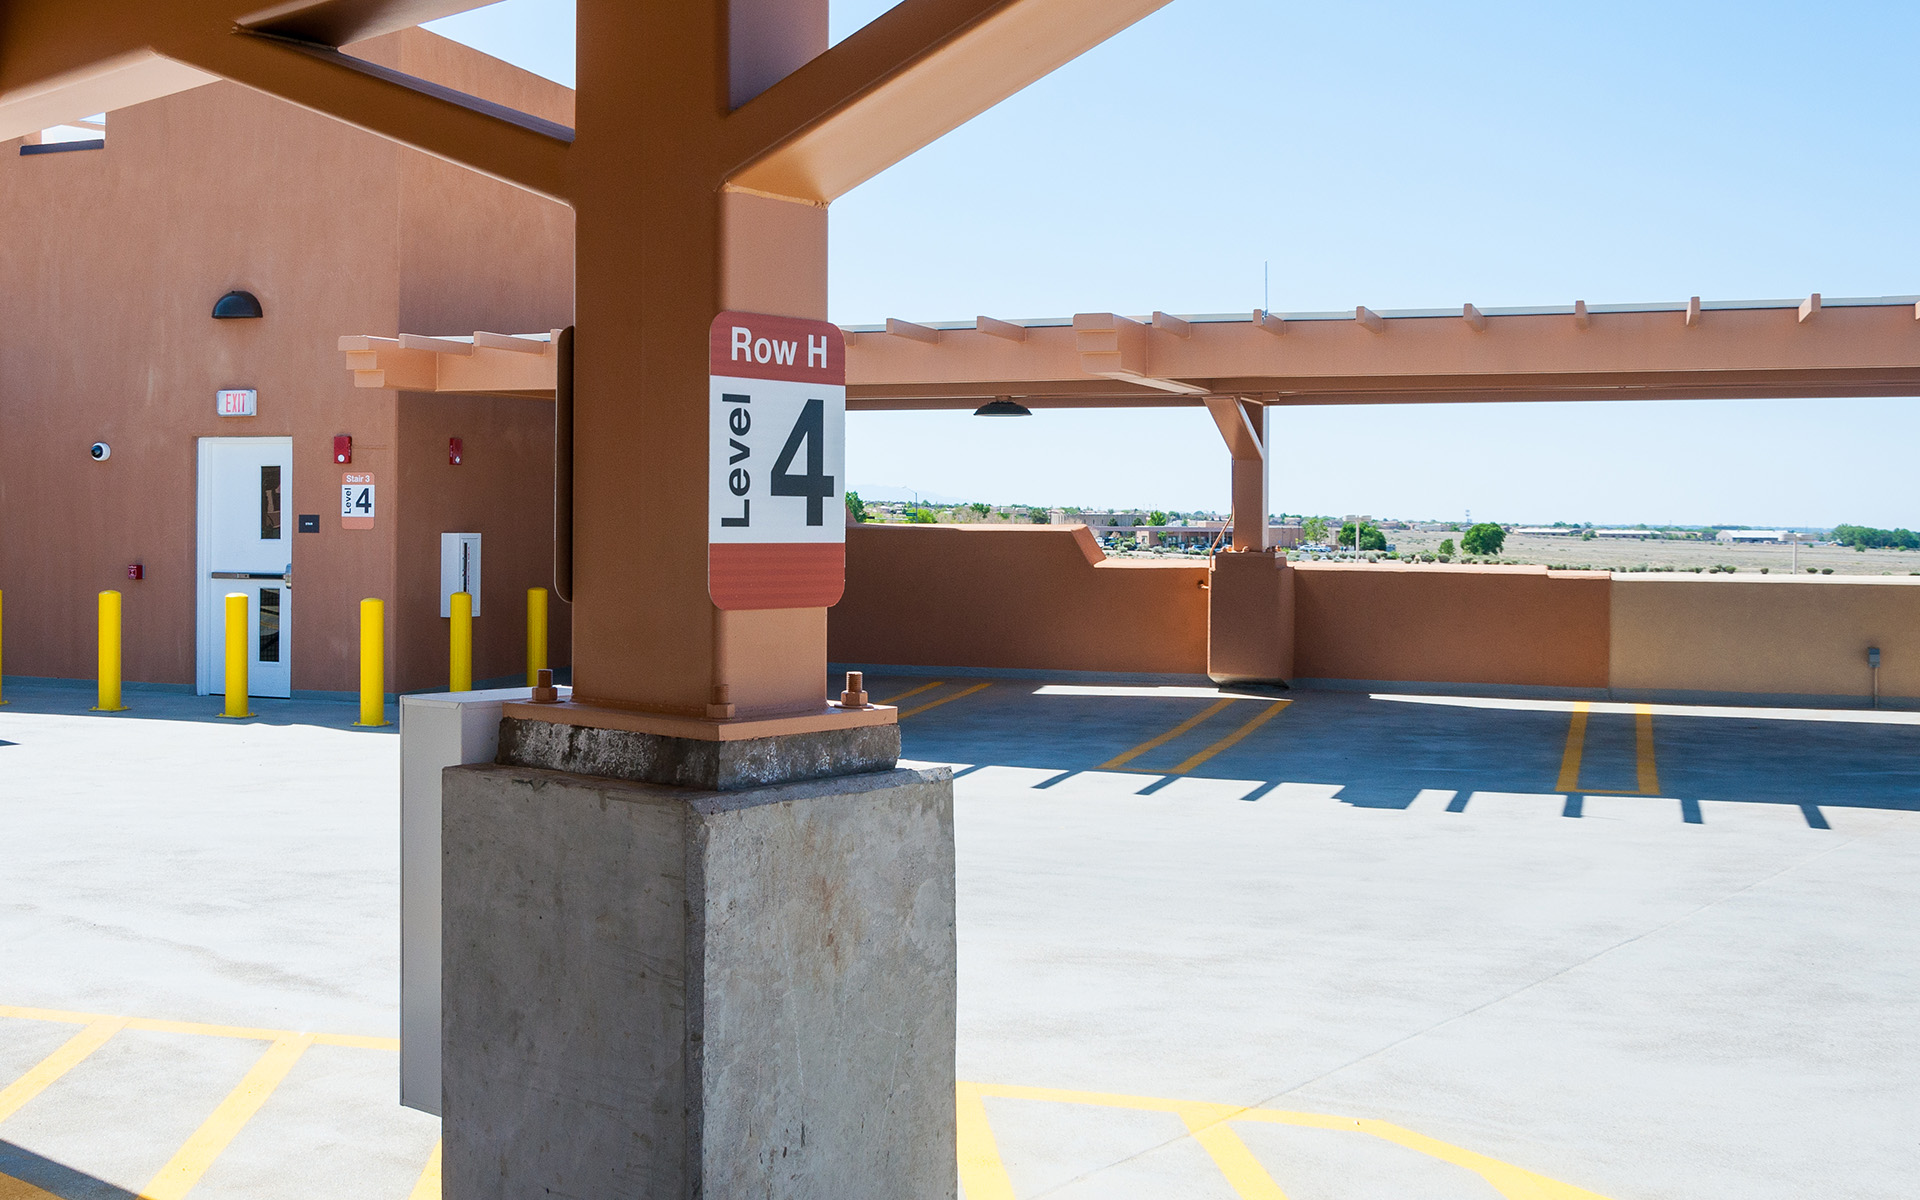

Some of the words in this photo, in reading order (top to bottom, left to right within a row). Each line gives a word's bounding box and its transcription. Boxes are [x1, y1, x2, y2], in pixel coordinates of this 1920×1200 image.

[731, 326, 798, 366] Row
[807, 334, 828, 369] H
[225, 393, 246, 413] EXIT
[721, 393, 751, 528] Level
[770, 398, 835, 527] 4
[346, 474, 364, 483] Stair
[365, 474, 371, 483] 3
[344, 487, 352, 514] Level
[355, 487, 372, 514] 4
